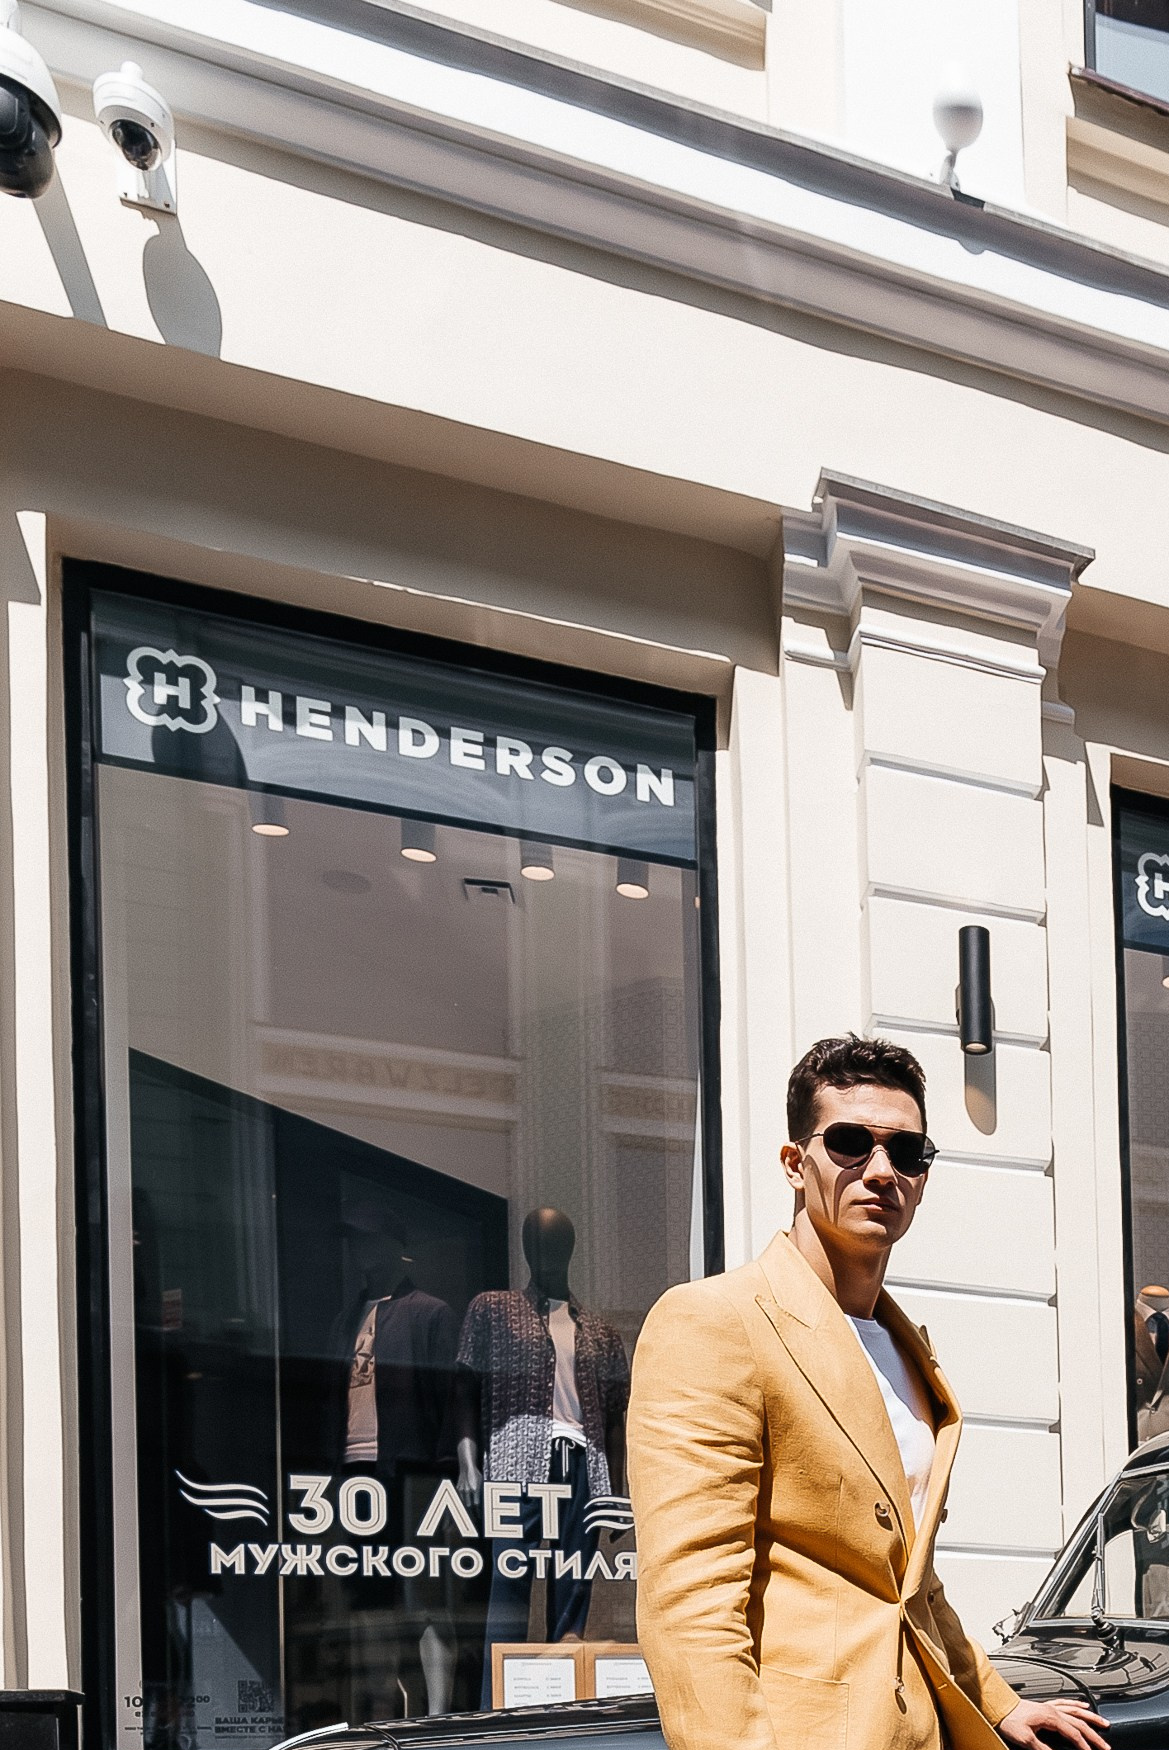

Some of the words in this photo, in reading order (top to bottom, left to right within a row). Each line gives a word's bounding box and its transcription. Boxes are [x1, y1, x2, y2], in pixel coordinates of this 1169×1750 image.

[241, 684, 675, 807] HENDERSON
[288, 1474, 388, 1536] 30
[416, 1479, 573, 1540] ЛЕТ
[210, 1543, 484, 1578] МУЖСКОГО
[497, 1548, 638, 1581] СТИЛЯ
